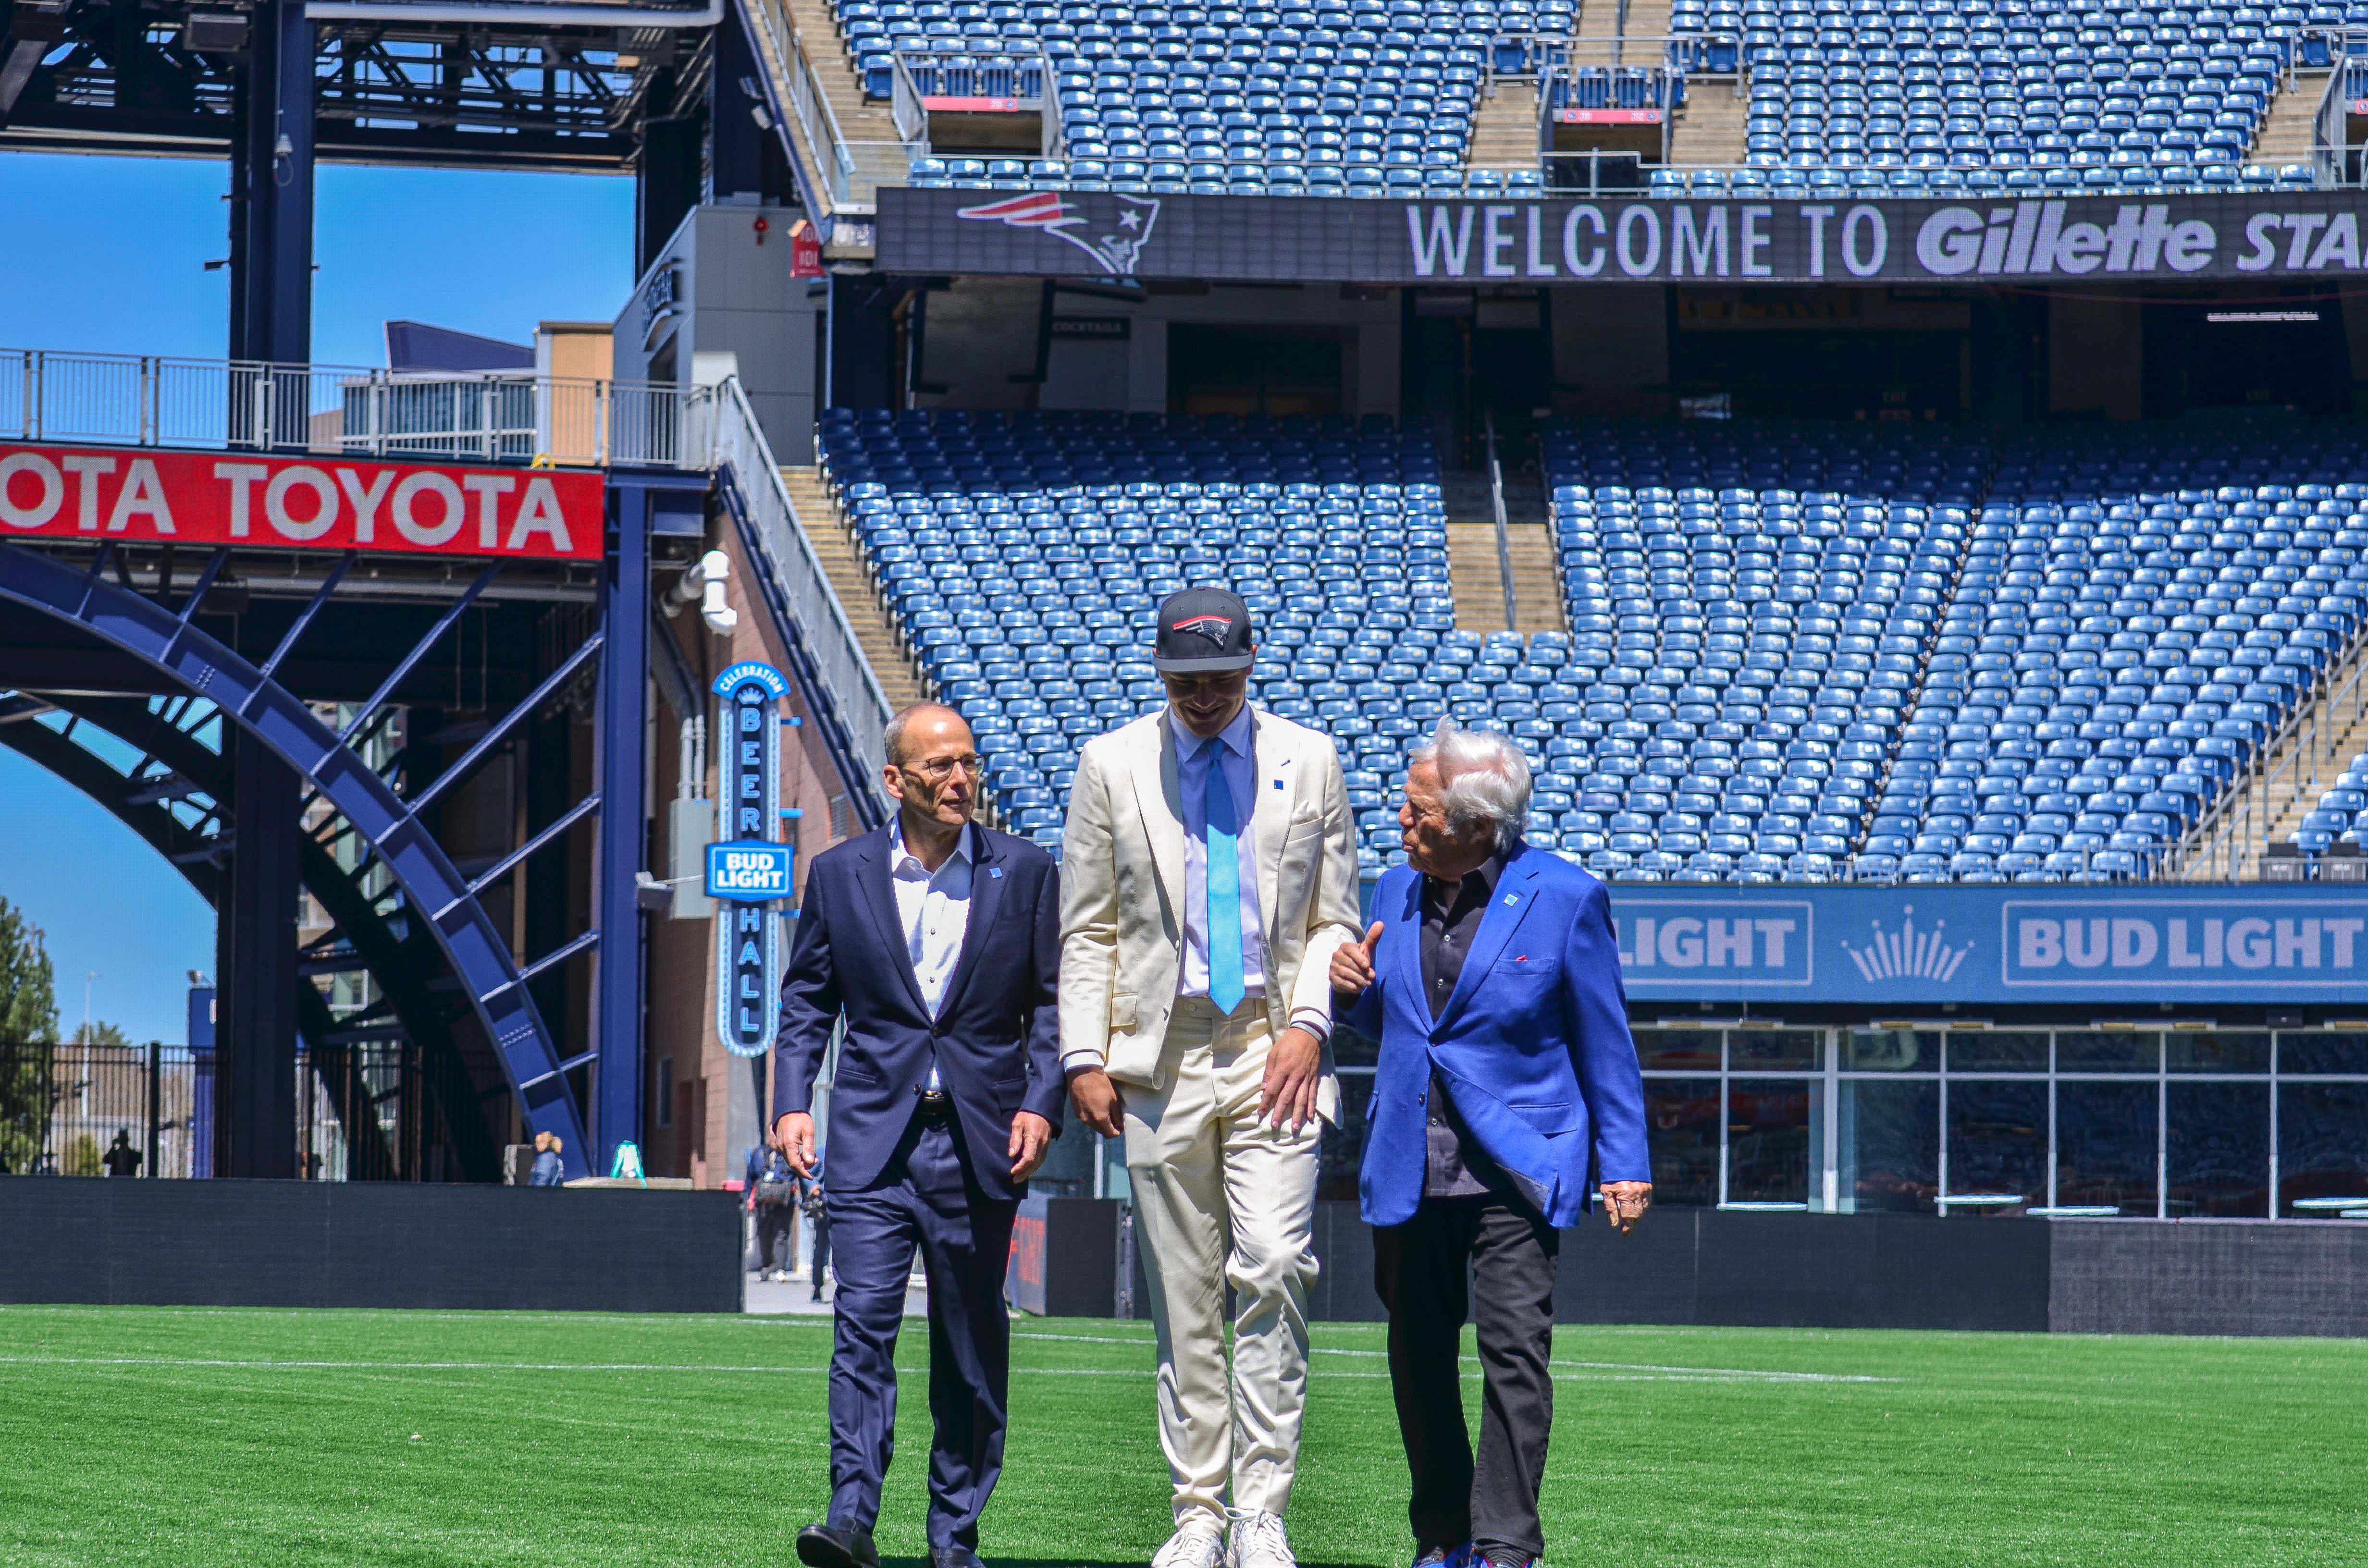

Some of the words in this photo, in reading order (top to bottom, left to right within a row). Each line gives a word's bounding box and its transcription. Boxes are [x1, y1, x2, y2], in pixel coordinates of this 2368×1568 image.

[1406, 204, 1773, 277] WELCOME
[1801, 204, 1888, 277] TO
[1916, 200, 2217, 275] Gillette
[2236, 212, 2368, 270] STA
[0, 452, 176, 534] OTA
[215, 462, 574, 552] TOYOTA
[719, 665, 784, 693] CELEBRATION
[740, 708, 761, 831] BEER
[717, 870, 783, 888] LIGHT
[727, 853, 774, 870] BUD
[1611, 917, 1796, 968] IGHT
[2019, 918, 2158, 968] BUD
[2168, 918, 2364, 968] LIGHT
[738, 908, 761, 1032] HALL
